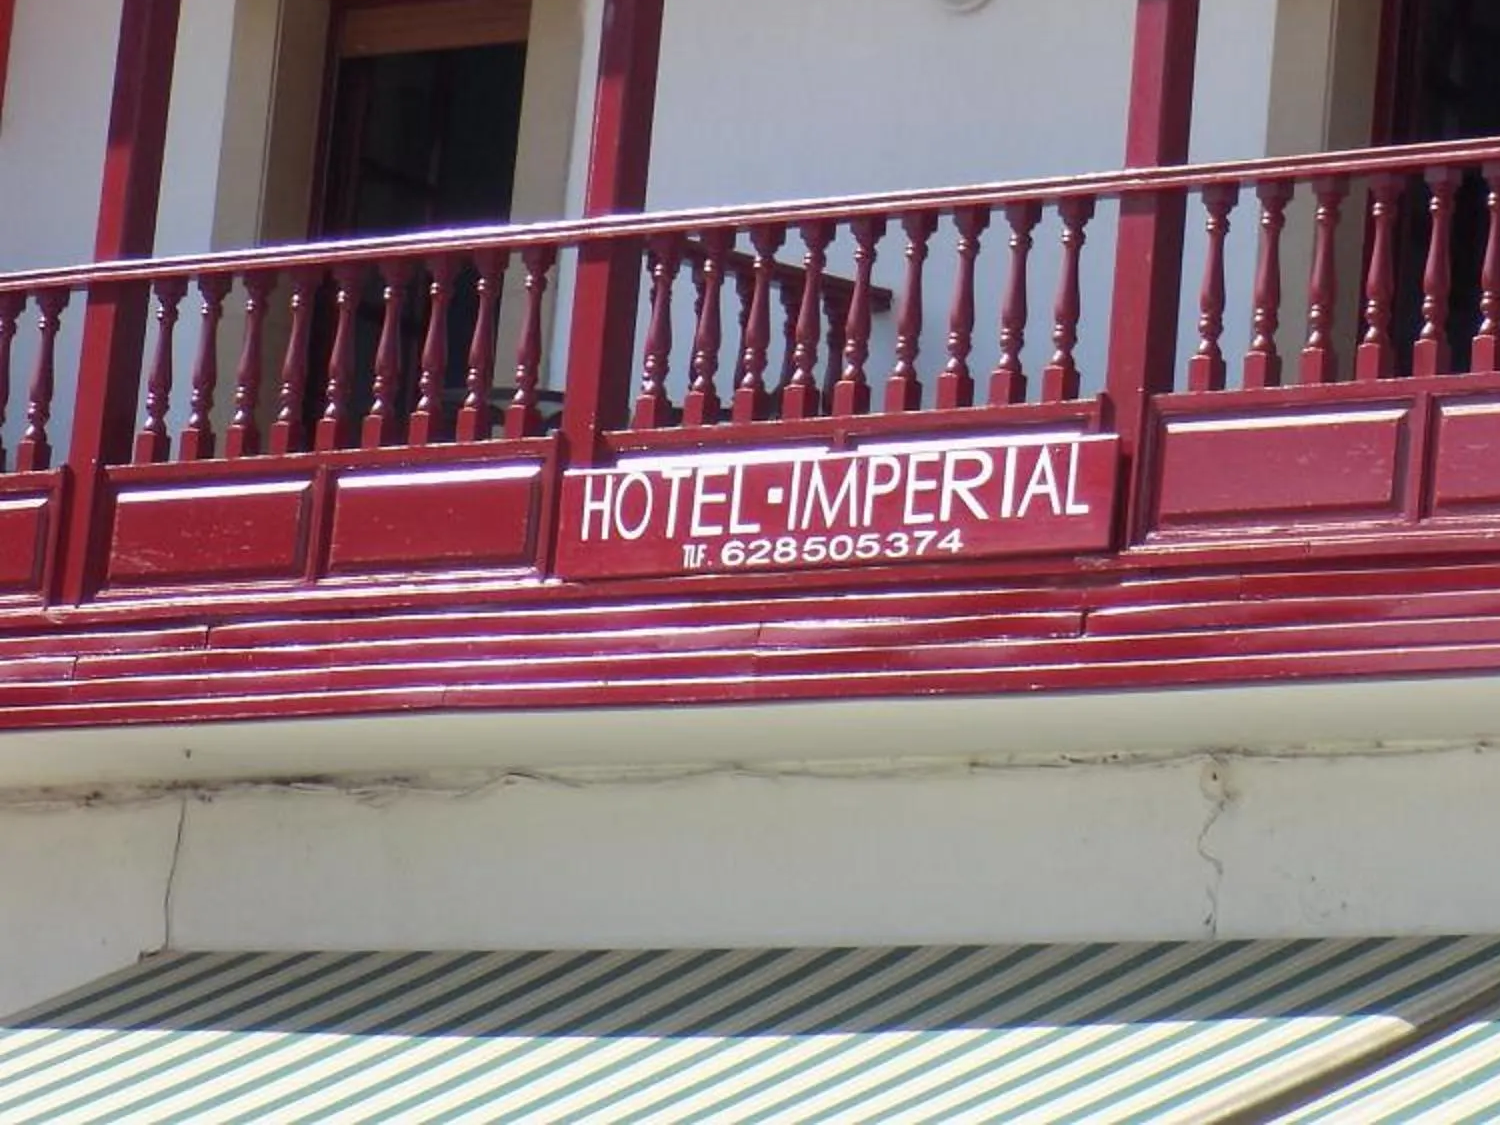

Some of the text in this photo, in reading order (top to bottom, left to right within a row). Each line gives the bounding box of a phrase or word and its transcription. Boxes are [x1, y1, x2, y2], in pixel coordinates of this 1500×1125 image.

[581, 442, 1089, 540] HOTEL IMPERIAL
[721, 528, 963, 566] 628505374
